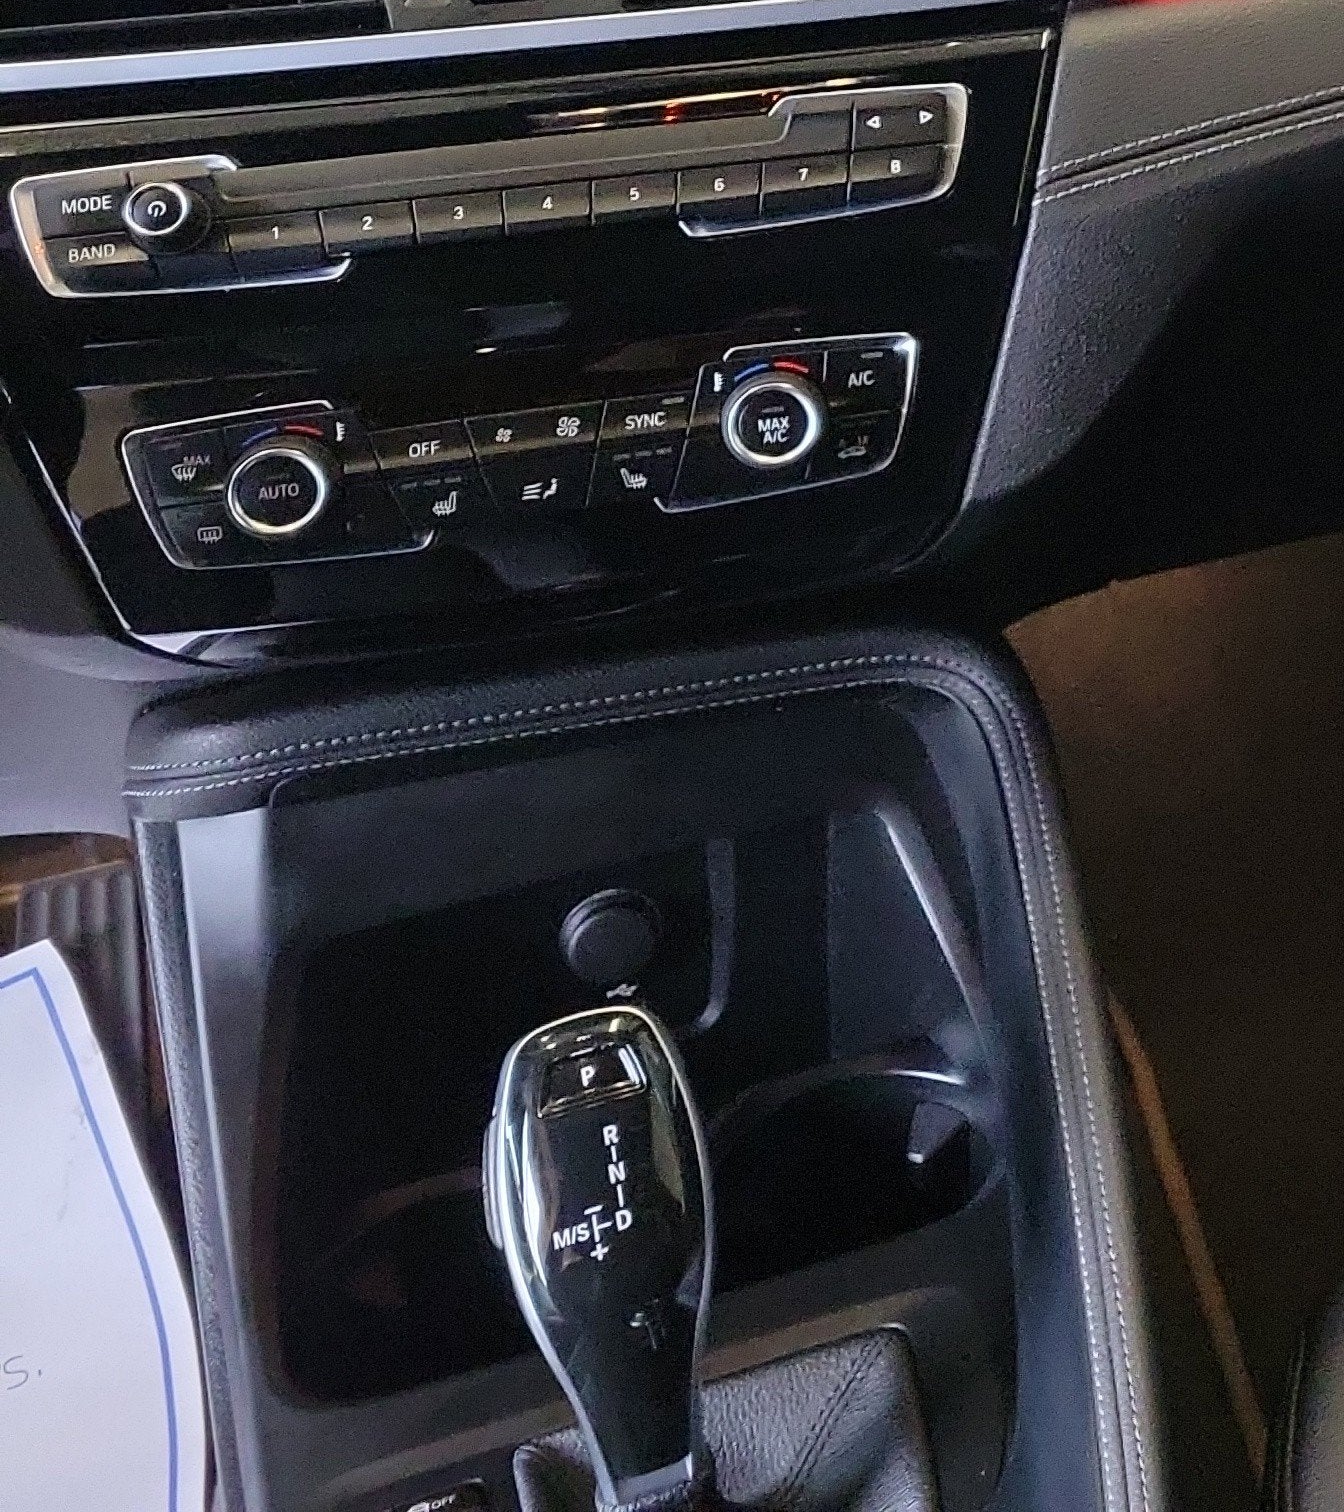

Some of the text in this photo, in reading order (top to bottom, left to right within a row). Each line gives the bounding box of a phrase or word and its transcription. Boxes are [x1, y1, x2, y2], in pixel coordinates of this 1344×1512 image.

[61, 194, 113, 215] MODE
[271, 159, 902, 239] 1 2 3 4 5 6 7 8
[68, 243, 116, 264] BAND
[848, 369, 876, 389] A/C
[625, 411, 667, 430] SYNC
[757, 416, 790, 434] MAX
[762, 429, 789, 445] A/C
[408, 439, 442, 458] OFF
[183, 453, 211, 466] MAX
[258, 482, 300, 501] AUTO
[580, 1066, 596, 1087] P
[603, 1124, 620, 1146] R
[608, 1161, 626, 1185] N
[615, 1209, 632, 1231] D
[552, 1221, 591, 1251] M/S
